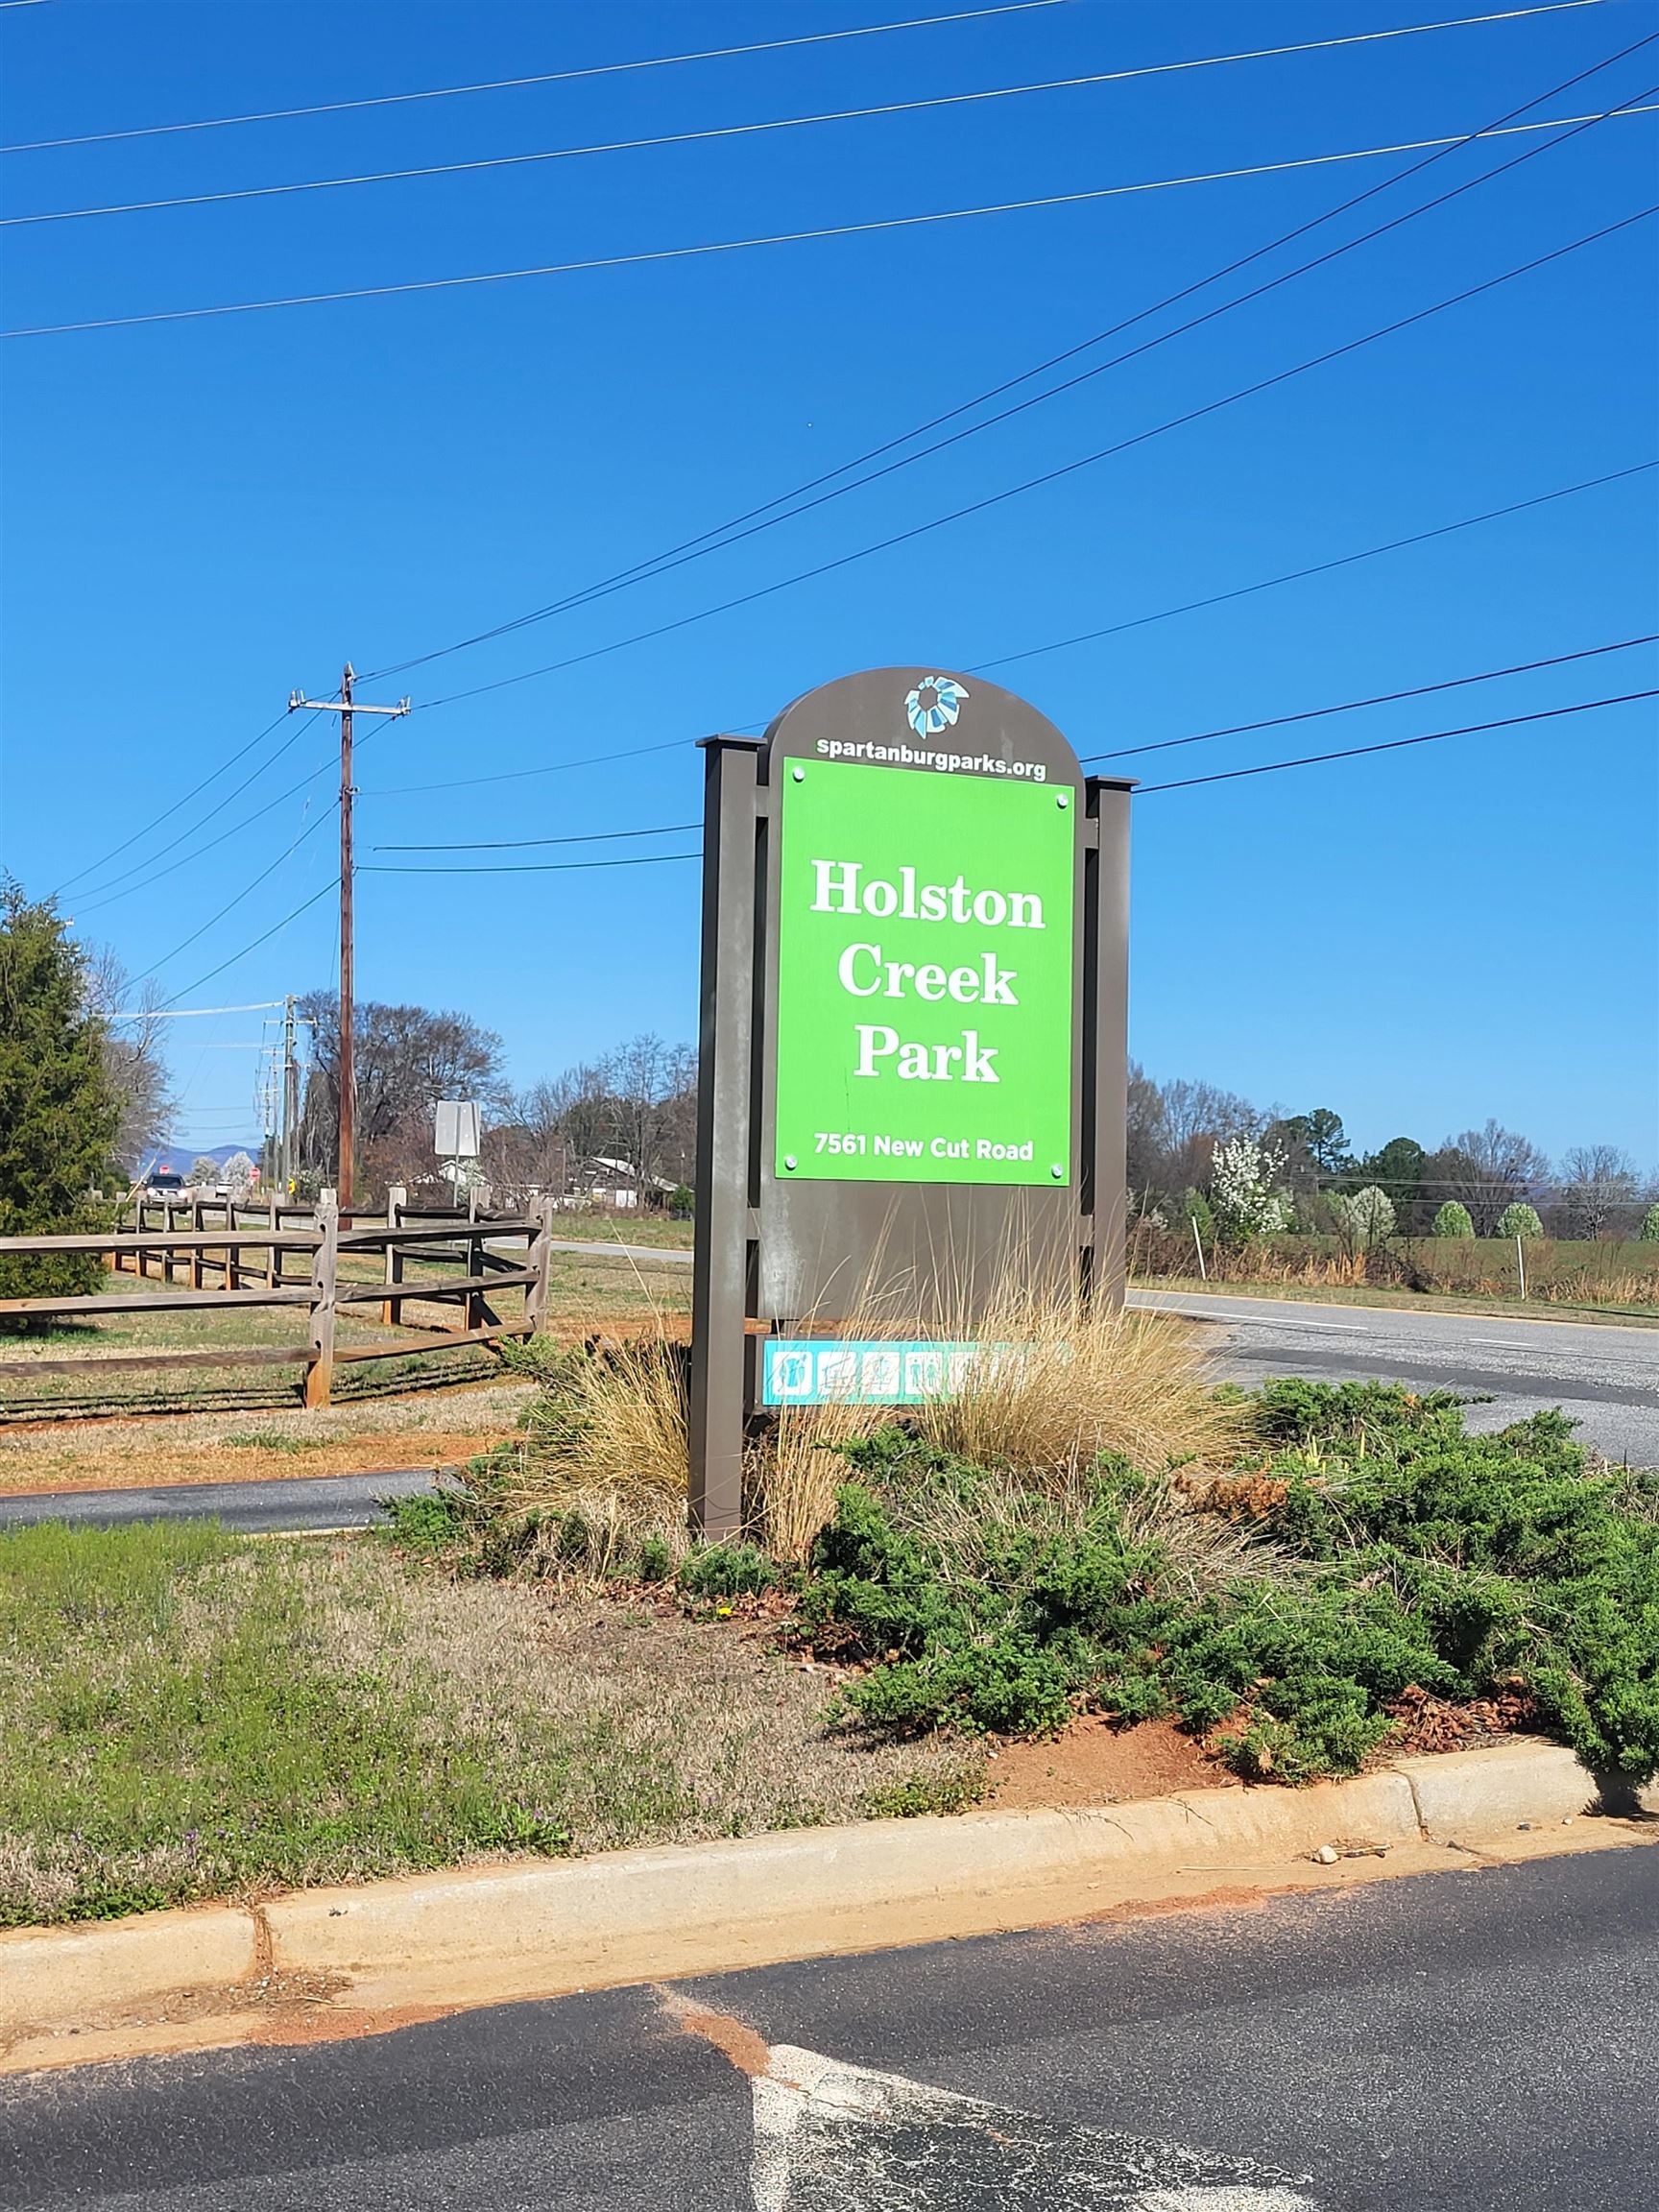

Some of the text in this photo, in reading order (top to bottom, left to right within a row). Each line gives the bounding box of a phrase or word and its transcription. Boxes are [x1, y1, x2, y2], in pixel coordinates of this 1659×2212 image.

[816, 736, 1047, 782] spartanburgparks.org
[809, 859, 1046, 929] Holston
[837, 942, 1020, 1006] Creek
[853, 1023, 1000, 1083] Park
[813, 1132, 1034, 1162] 7561 New Cut Road
